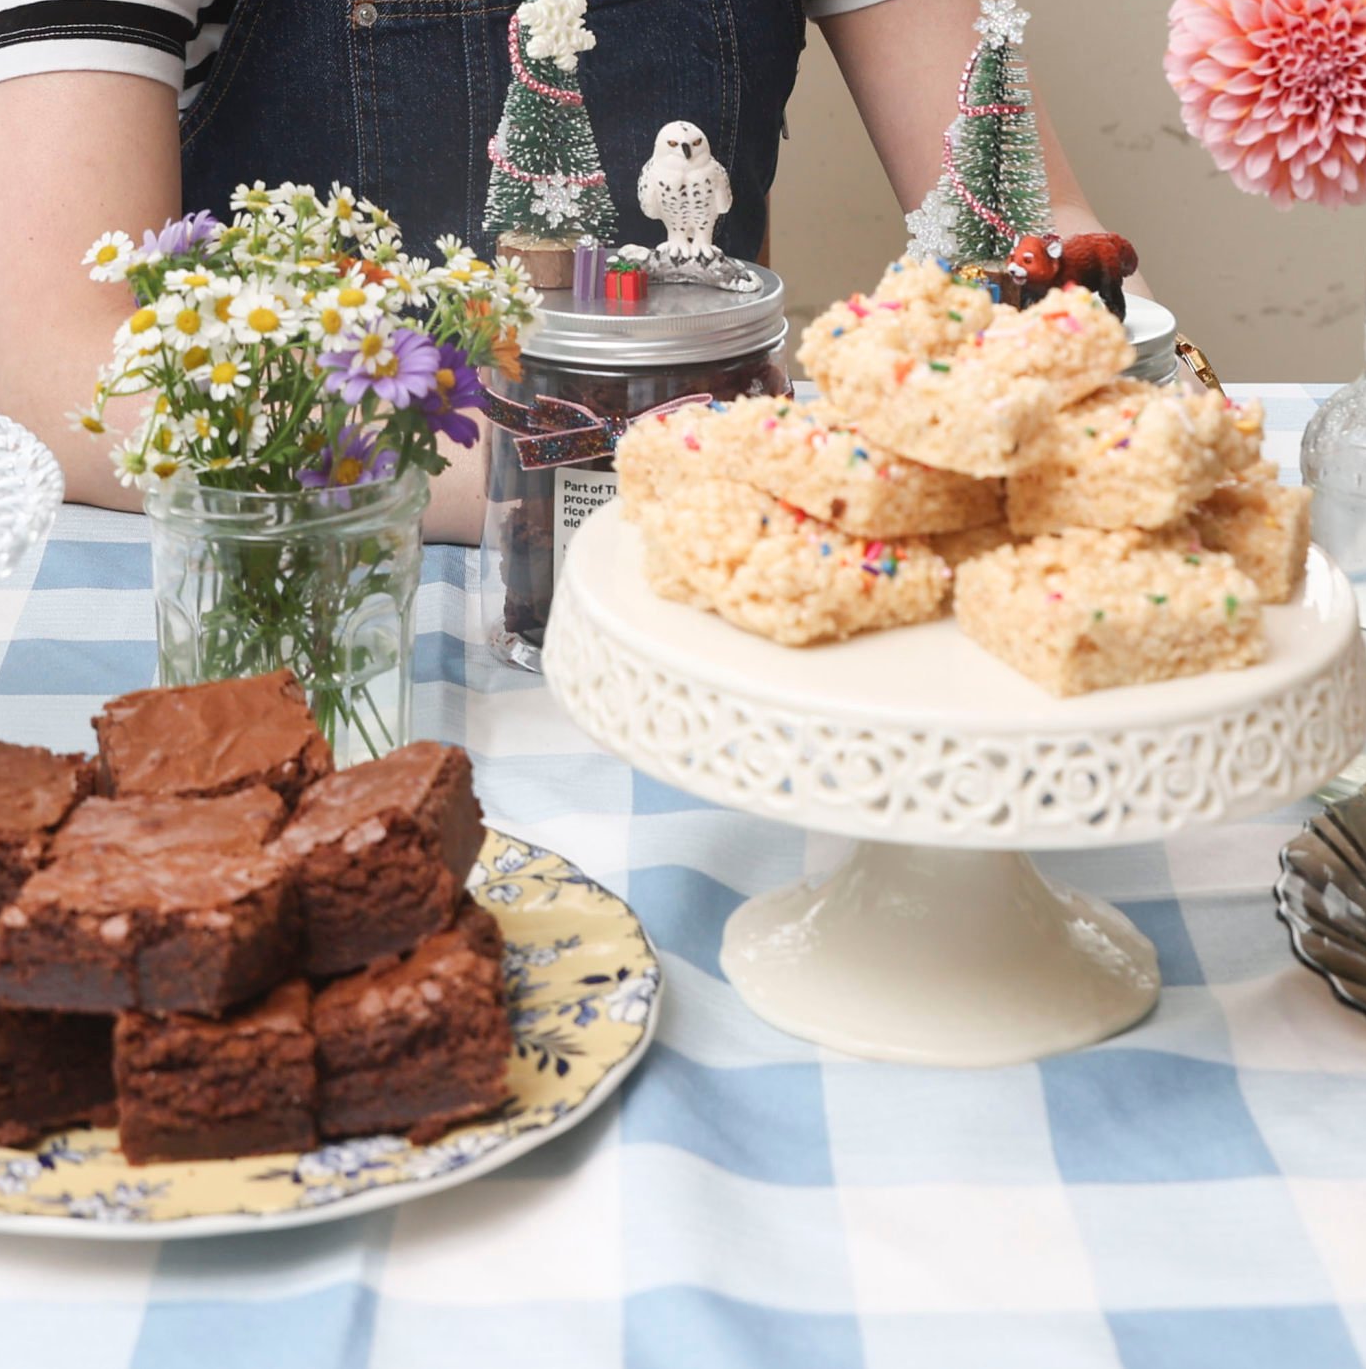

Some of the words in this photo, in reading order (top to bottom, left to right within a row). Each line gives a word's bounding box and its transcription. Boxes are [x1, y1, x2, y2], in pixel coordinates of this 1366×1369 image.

[564, 480, 588, 493] Part
[590, 484, 603, 494] of
[564, 494, 612, 506] procee
[564, 505, 585, 517] rice
